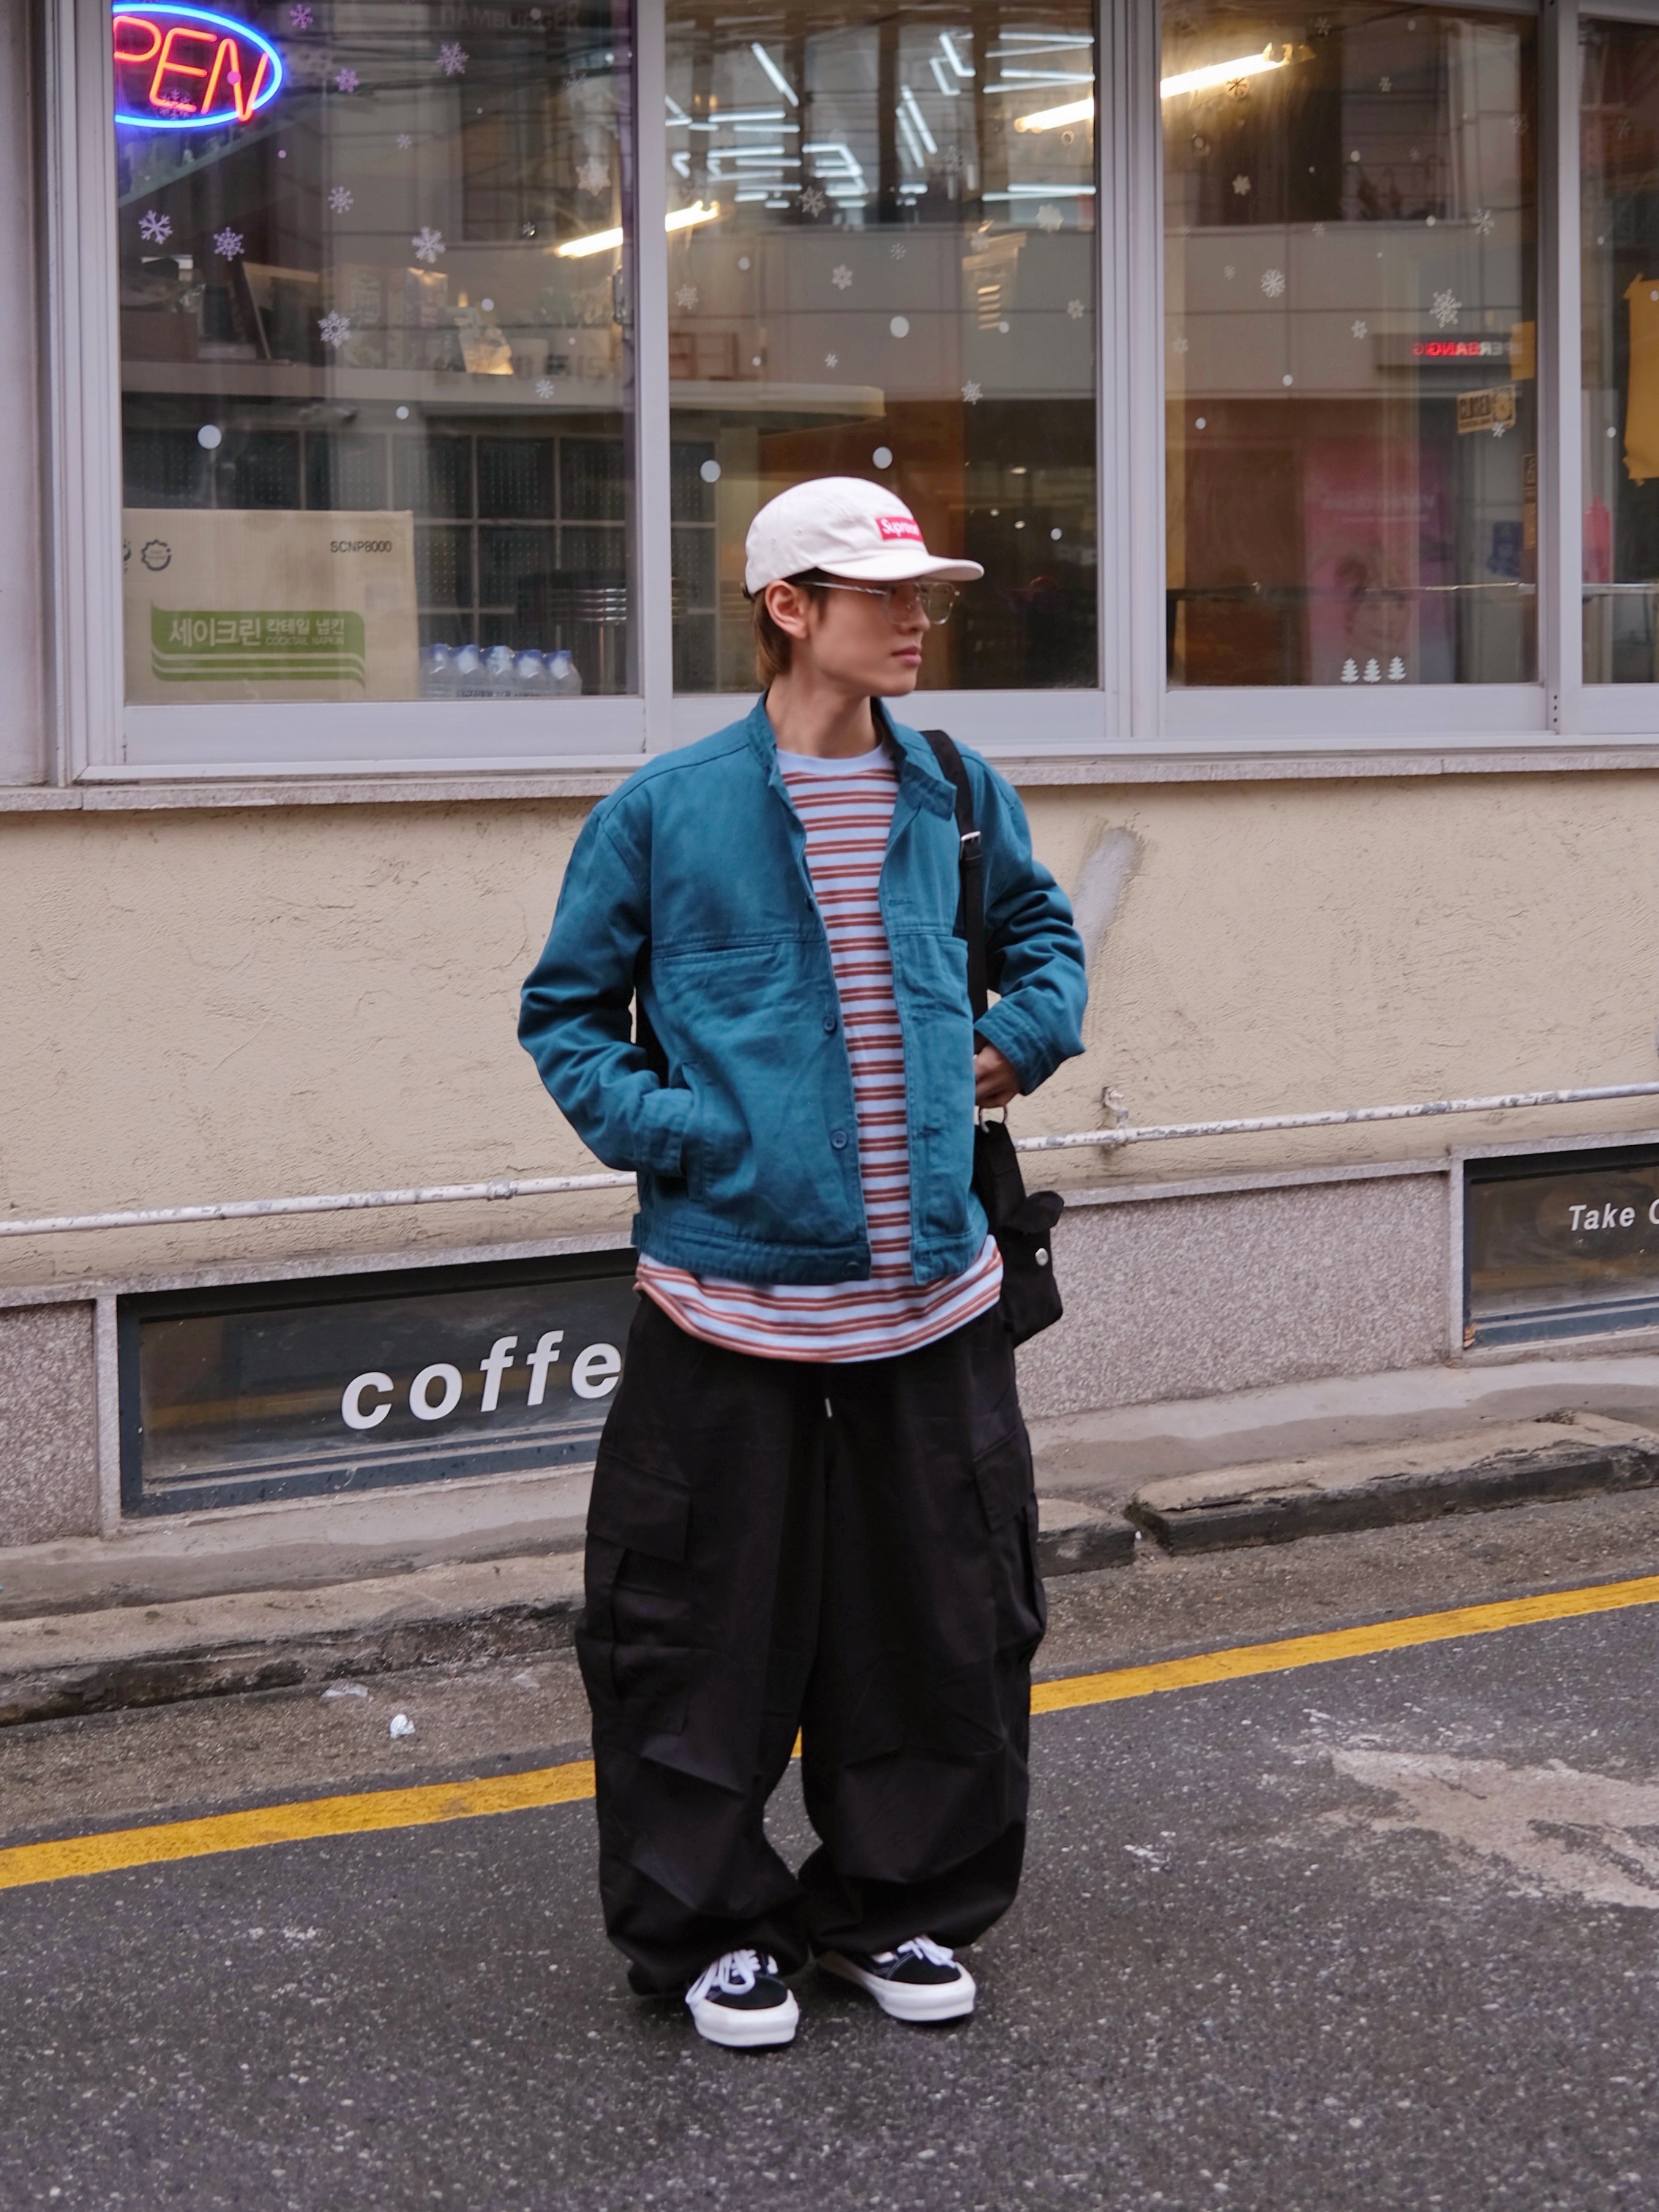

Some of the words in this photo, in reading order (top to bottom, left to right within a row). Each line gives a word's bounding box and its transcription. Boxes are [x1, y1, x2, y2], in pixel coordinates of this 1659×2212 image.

[113, 15, 269, 122] PEN
[330, 541, 392, 552] SCNP8000
[169, 618, 261, 647] 세이크린
[266, 618, 310, 635] 칵테일
[316, 618, 345, 635] 냅킨
[1568, 1202, 1636, 1231] Take
[342, 1330, 622, 1430] coffe
